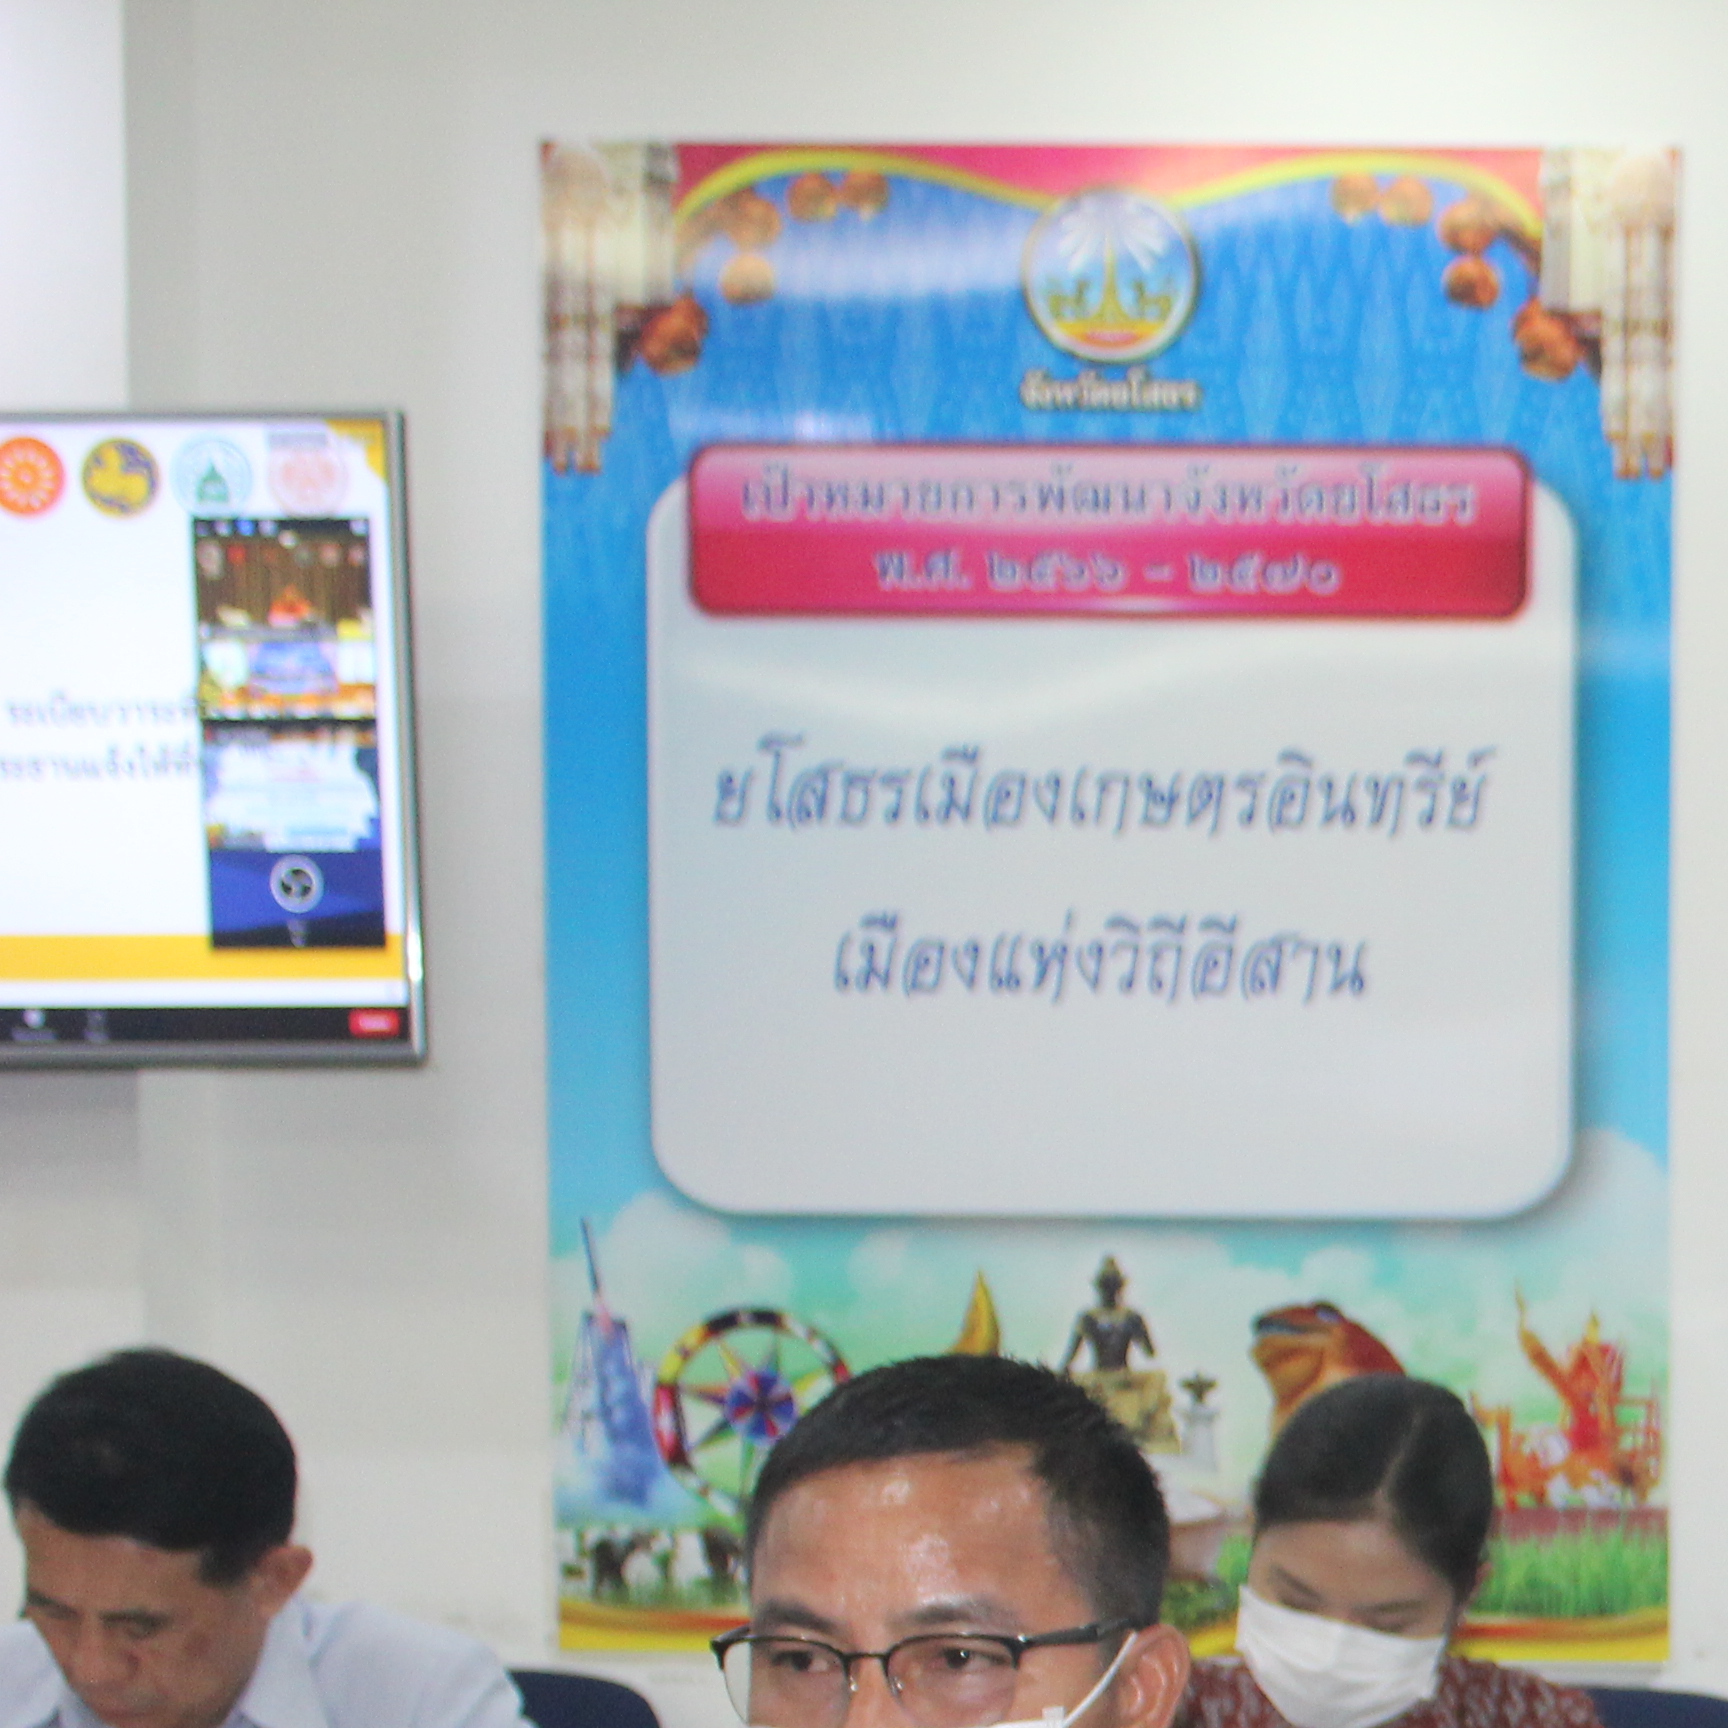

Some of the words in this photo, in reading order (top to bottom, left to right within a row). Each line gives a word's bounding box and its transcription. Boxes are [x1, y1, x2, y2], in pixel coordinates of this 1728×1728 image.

[874, 548, 970, 592] พ.ศ.
[987, 551, 1124, 592] ๒๕๖๖
[1187, 553, 1341, 594] ๒๕๗๐
[712, 730, 1498, 840] ยโสธรเมืองเกษตรอินทรีย์
[831, 906, 1369, 1003] เมืองแห่งวิถีอีสาน
